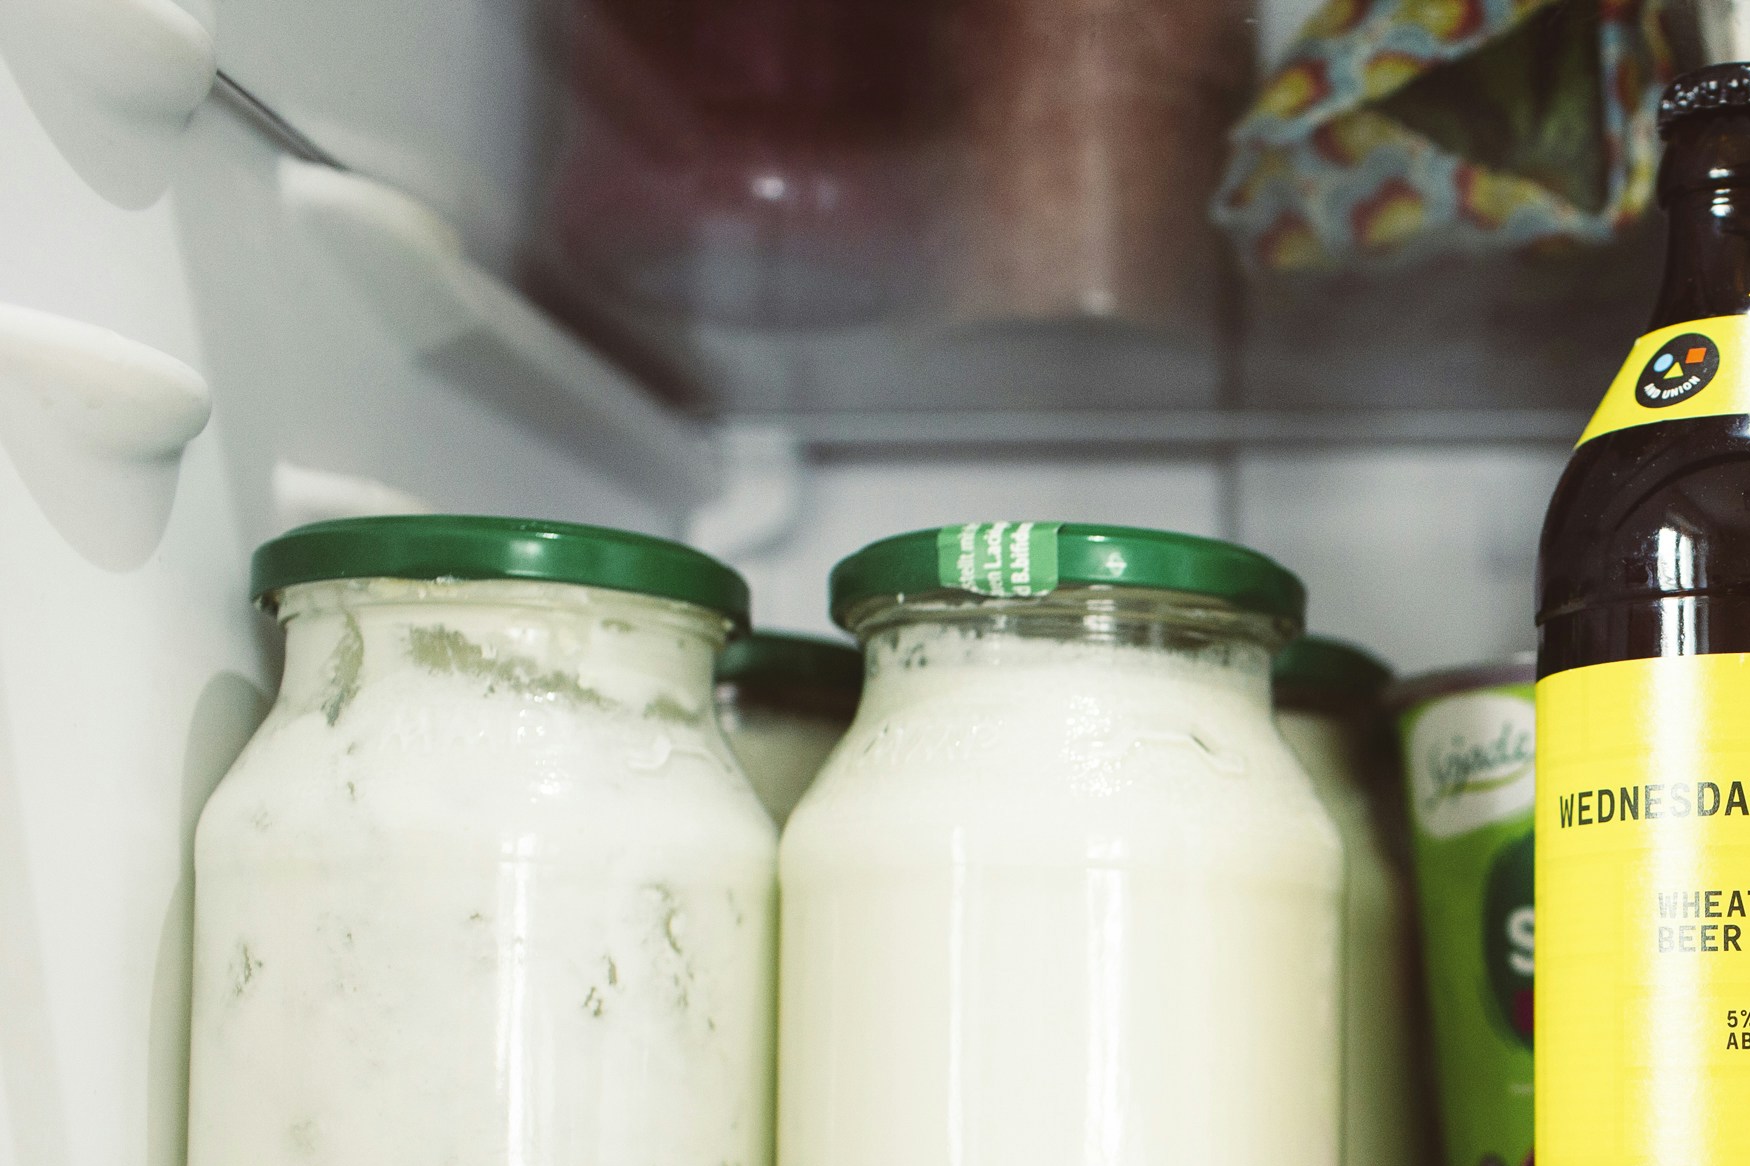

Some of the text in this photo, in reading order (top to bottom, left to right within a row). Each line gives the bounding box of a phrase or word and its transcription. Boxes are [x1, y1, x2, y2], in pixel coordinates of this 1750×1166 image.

[1644, 375, 1701, 400] AND UNION
[1658, 924, 1743, 953] BEER
